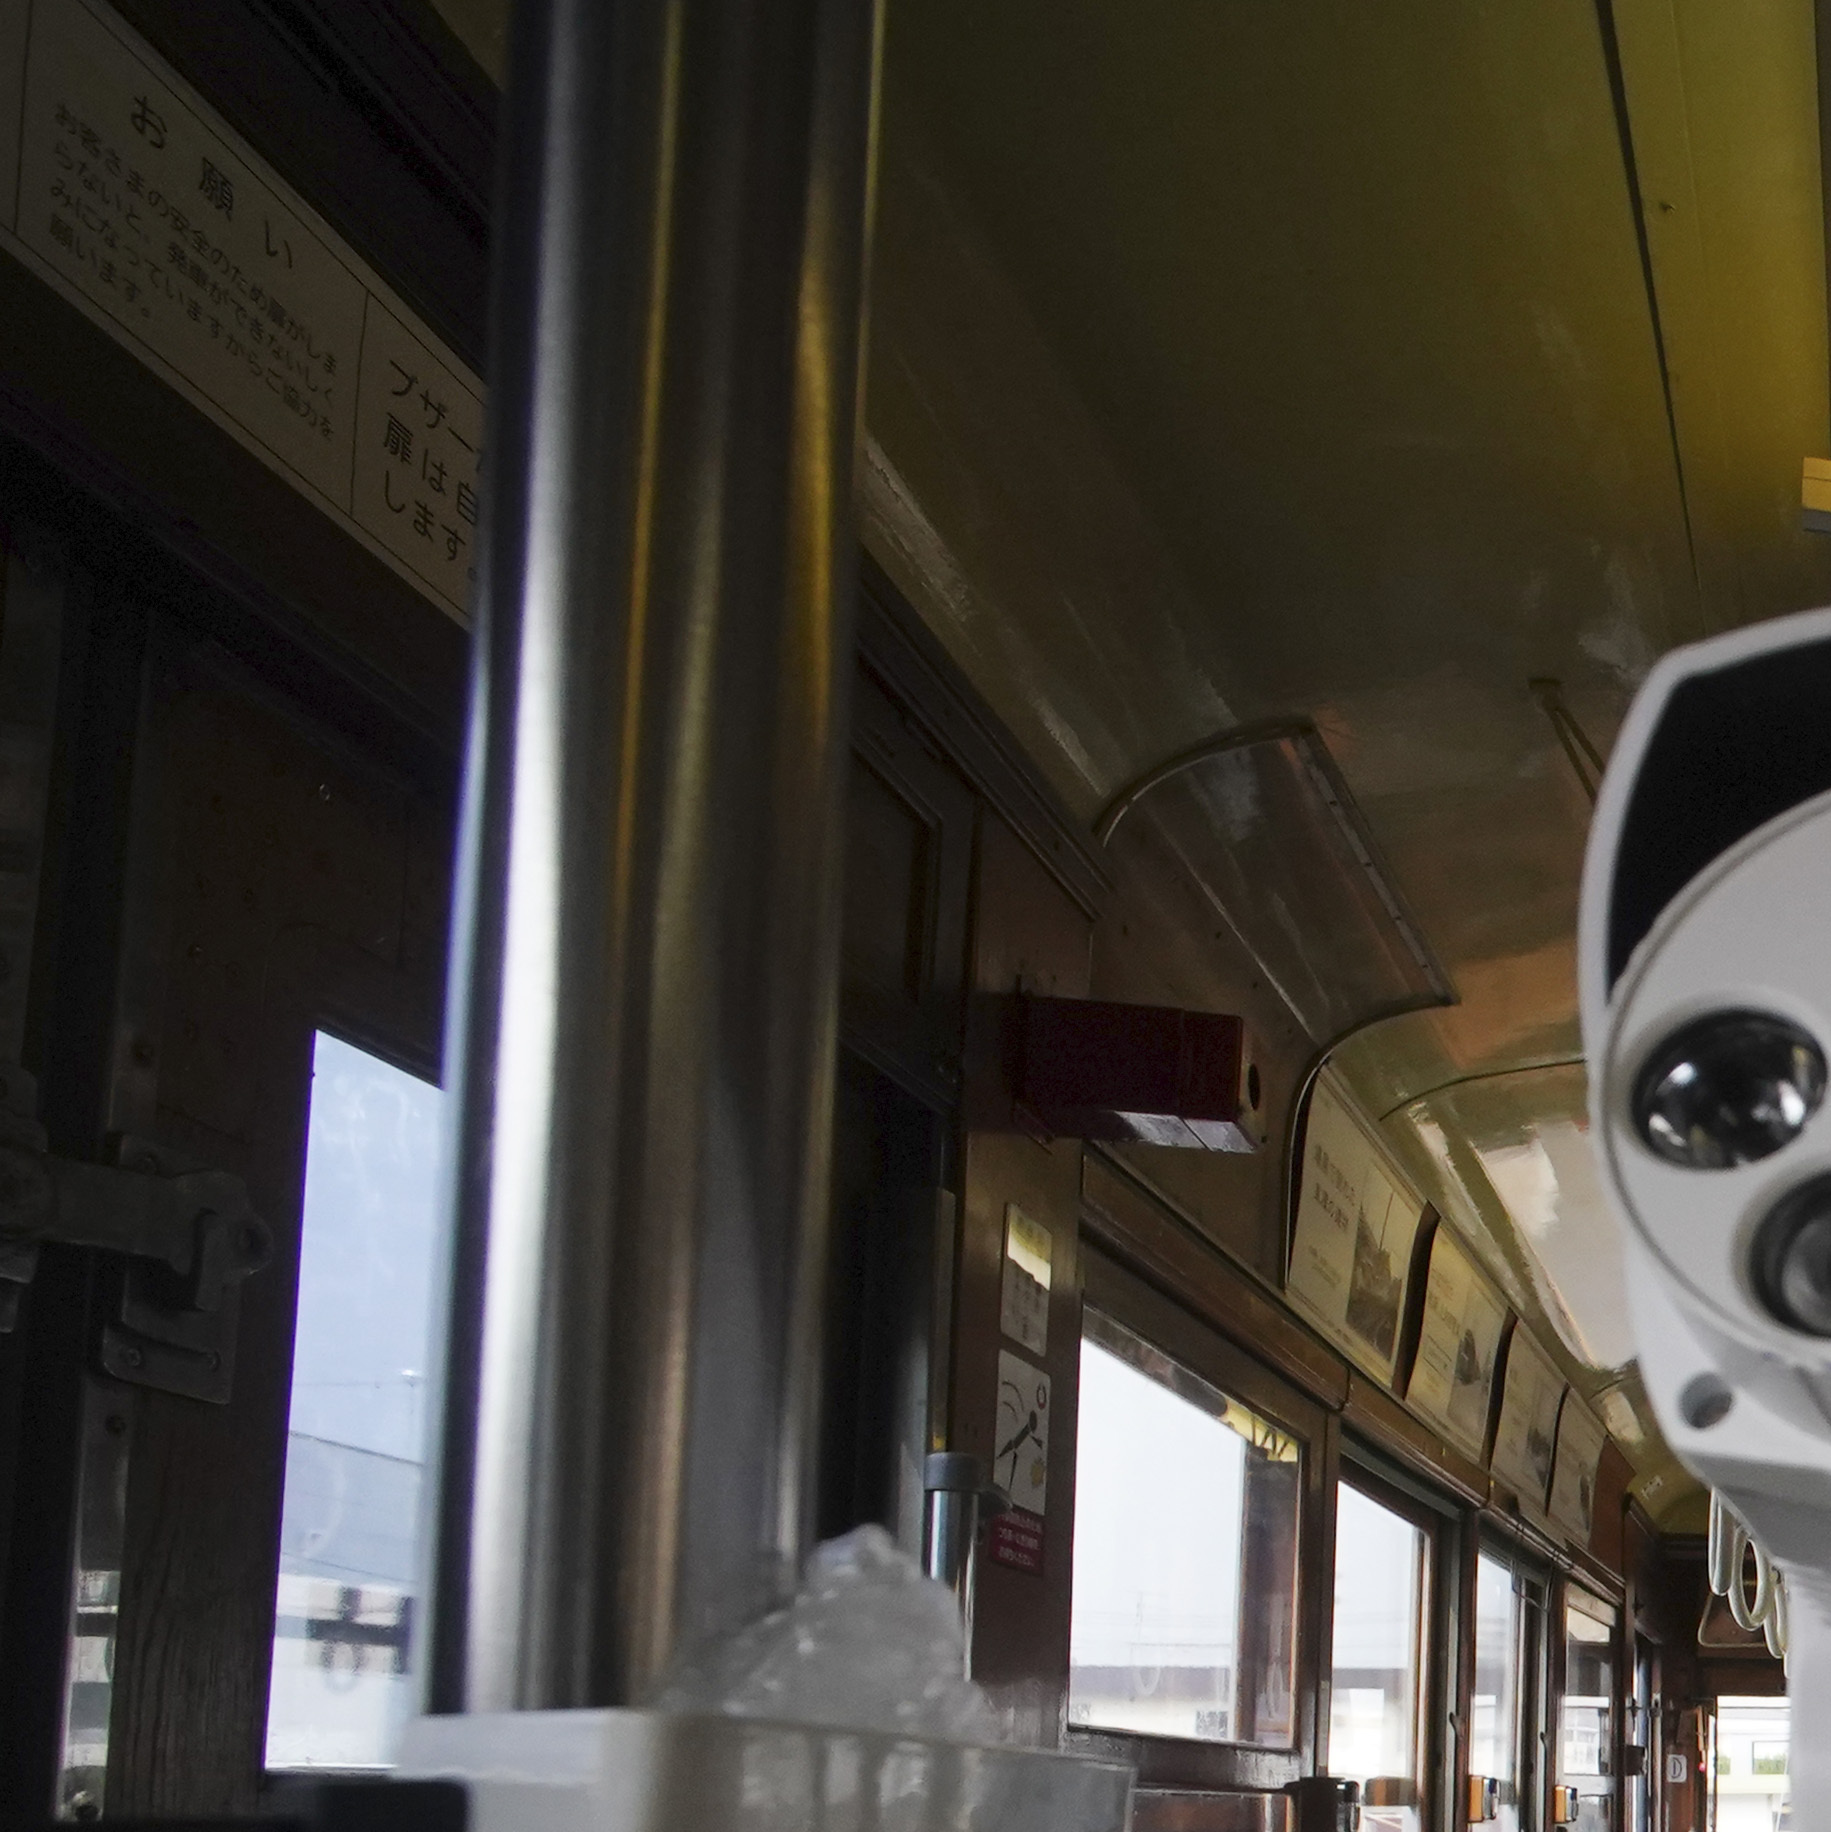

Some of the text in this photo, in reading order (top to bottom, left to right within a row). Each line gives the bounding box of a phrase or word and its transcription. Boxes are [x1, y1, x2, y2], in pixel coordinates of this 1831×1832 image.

[131, 94, 294, 270] お願い
[49, 213, 151, 321] 願います。
[389, 358, 480, 473] ブザー
